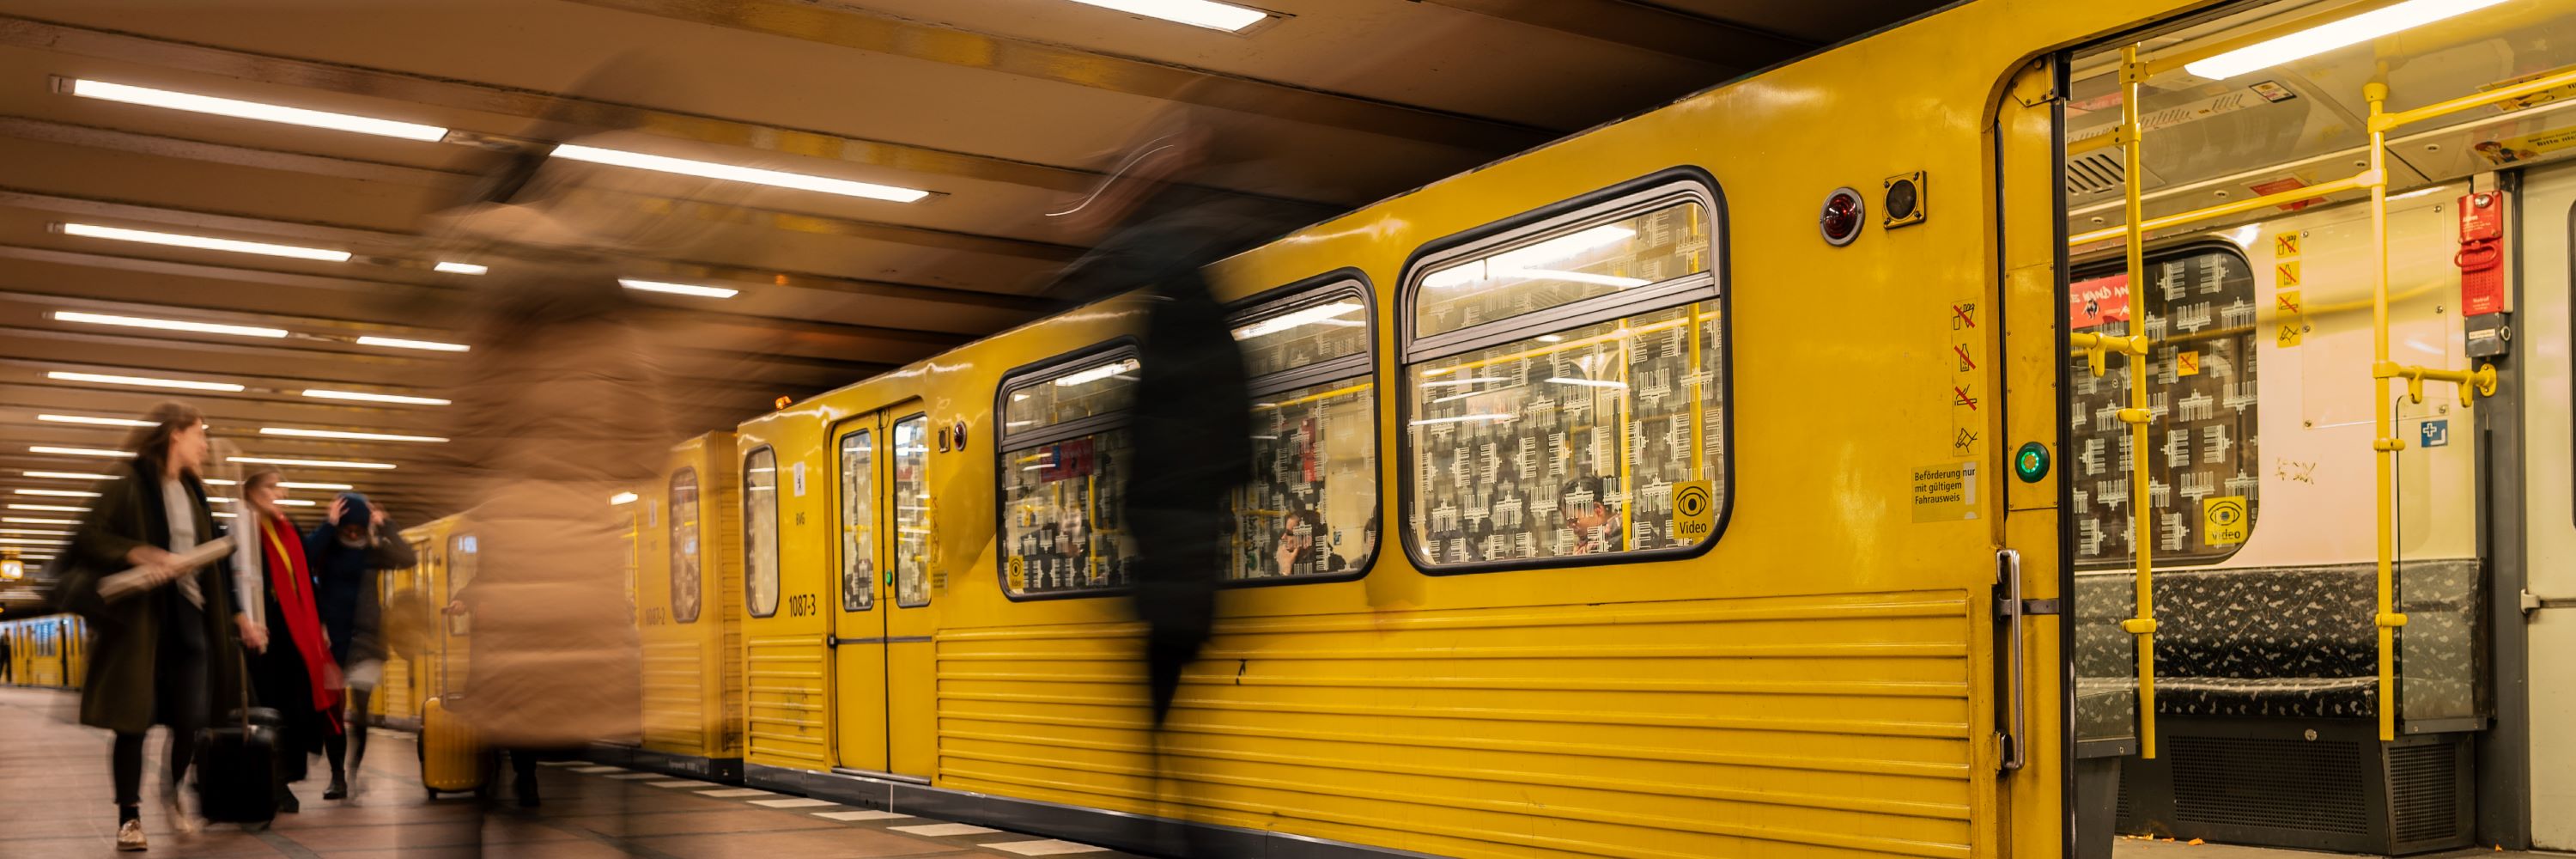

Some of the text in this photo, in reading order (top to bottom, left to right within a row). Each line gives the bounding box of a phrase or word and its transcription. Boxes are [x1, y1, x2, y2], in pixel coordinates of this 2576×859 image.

[1915, 468, 1976, 481] Beförderung nur
[1915, 482, 1962, 493] mit gültigem
[1915, 492, 1960, 504] Fahrausweis
[1680, 520, 1707, 534] Video
[788, 594, 816, 618] 1087-3
